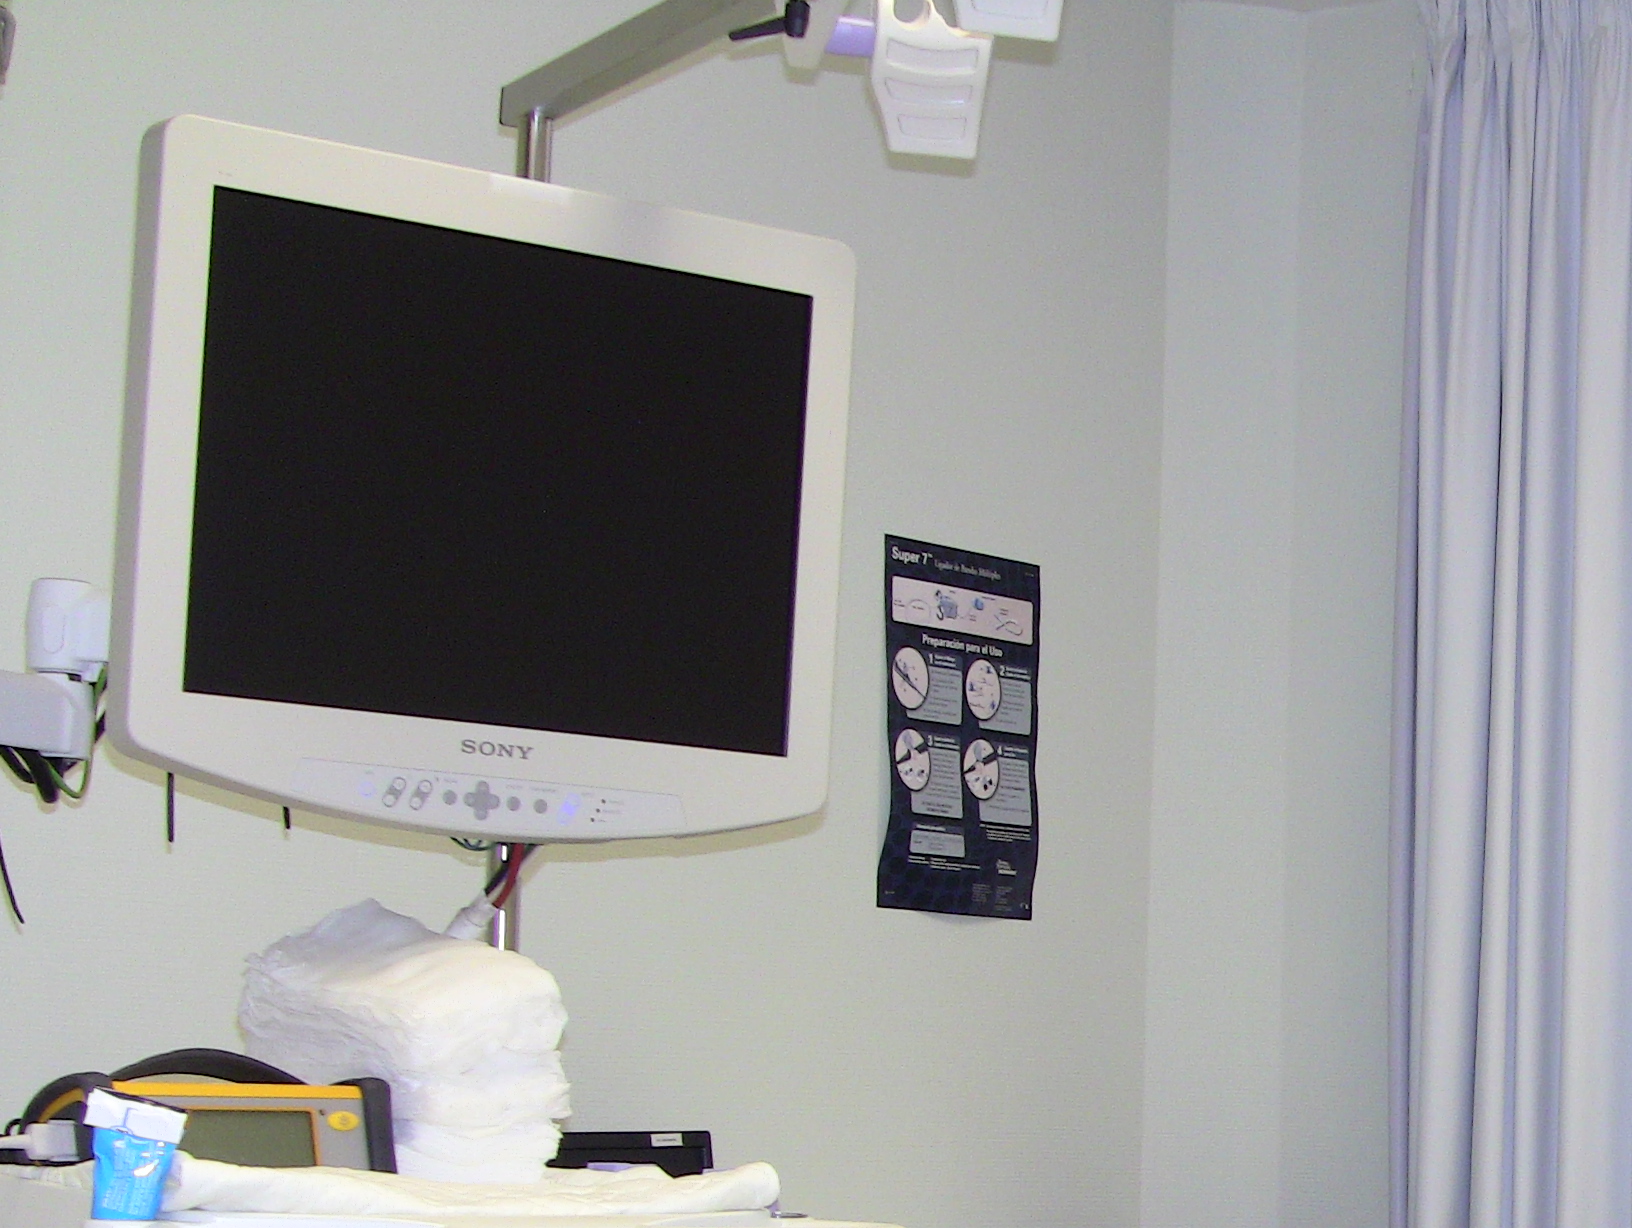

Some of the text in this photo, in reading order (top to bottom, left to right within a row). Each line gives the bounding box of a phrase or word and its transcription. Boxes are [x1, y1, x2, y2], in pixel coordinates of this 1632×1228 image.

[891, 545, 920, 565] Super
[921, 632, 965, 650] Preparación
[965, 642, 980, 654] para
[988, 645, 1003, 657] Uso
[461, 739, 534, 760] SONY
